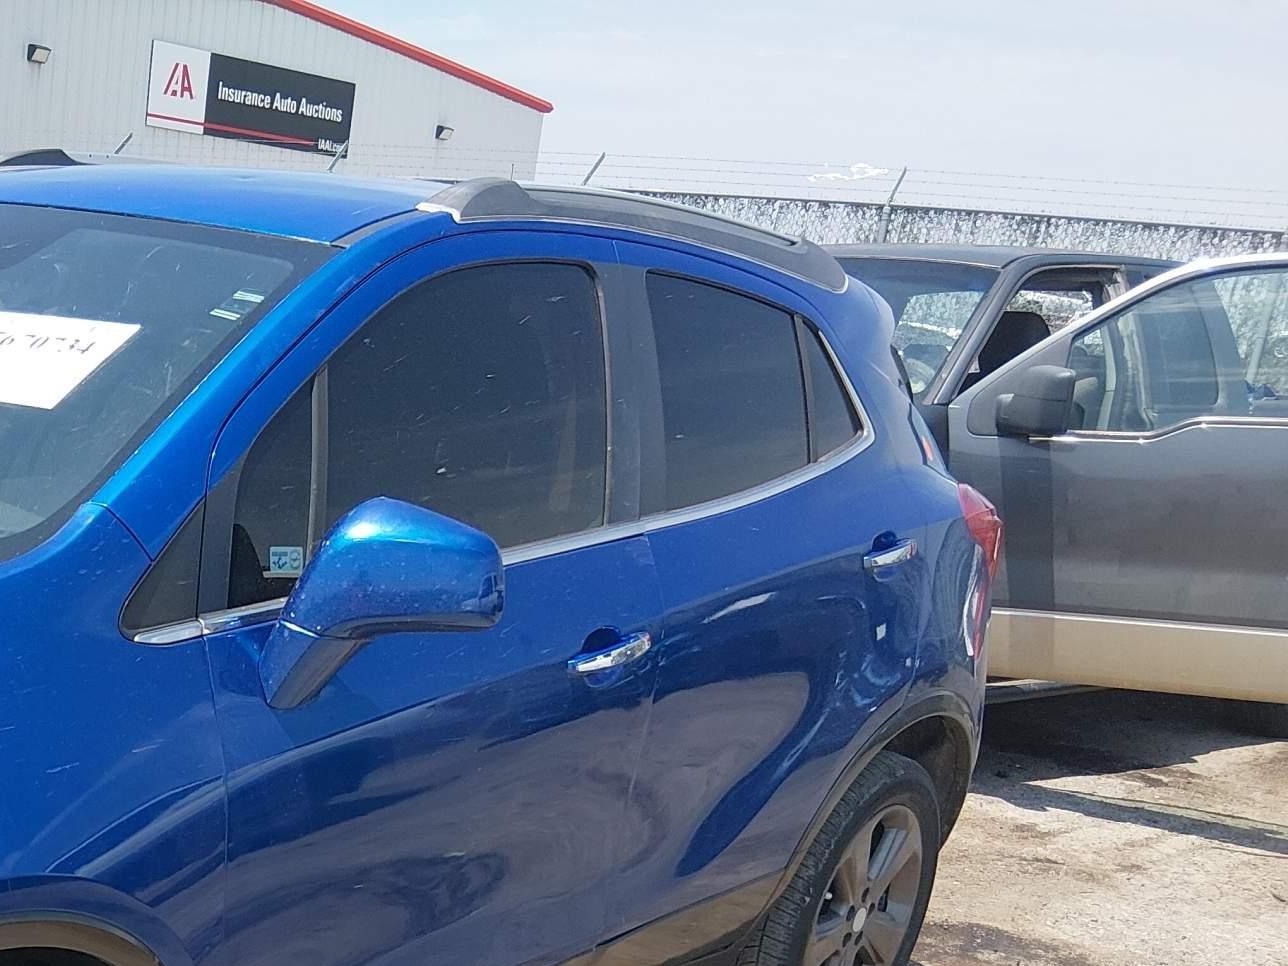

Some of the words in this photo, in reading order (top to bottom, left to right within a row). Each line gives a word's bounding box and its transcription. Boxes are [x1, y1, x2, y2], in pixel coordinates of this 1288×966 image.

[217, 81, 271, 109] Insurance
[272, 92, 297, 114] Auto
[298, 97, 343, 123] Auctions
